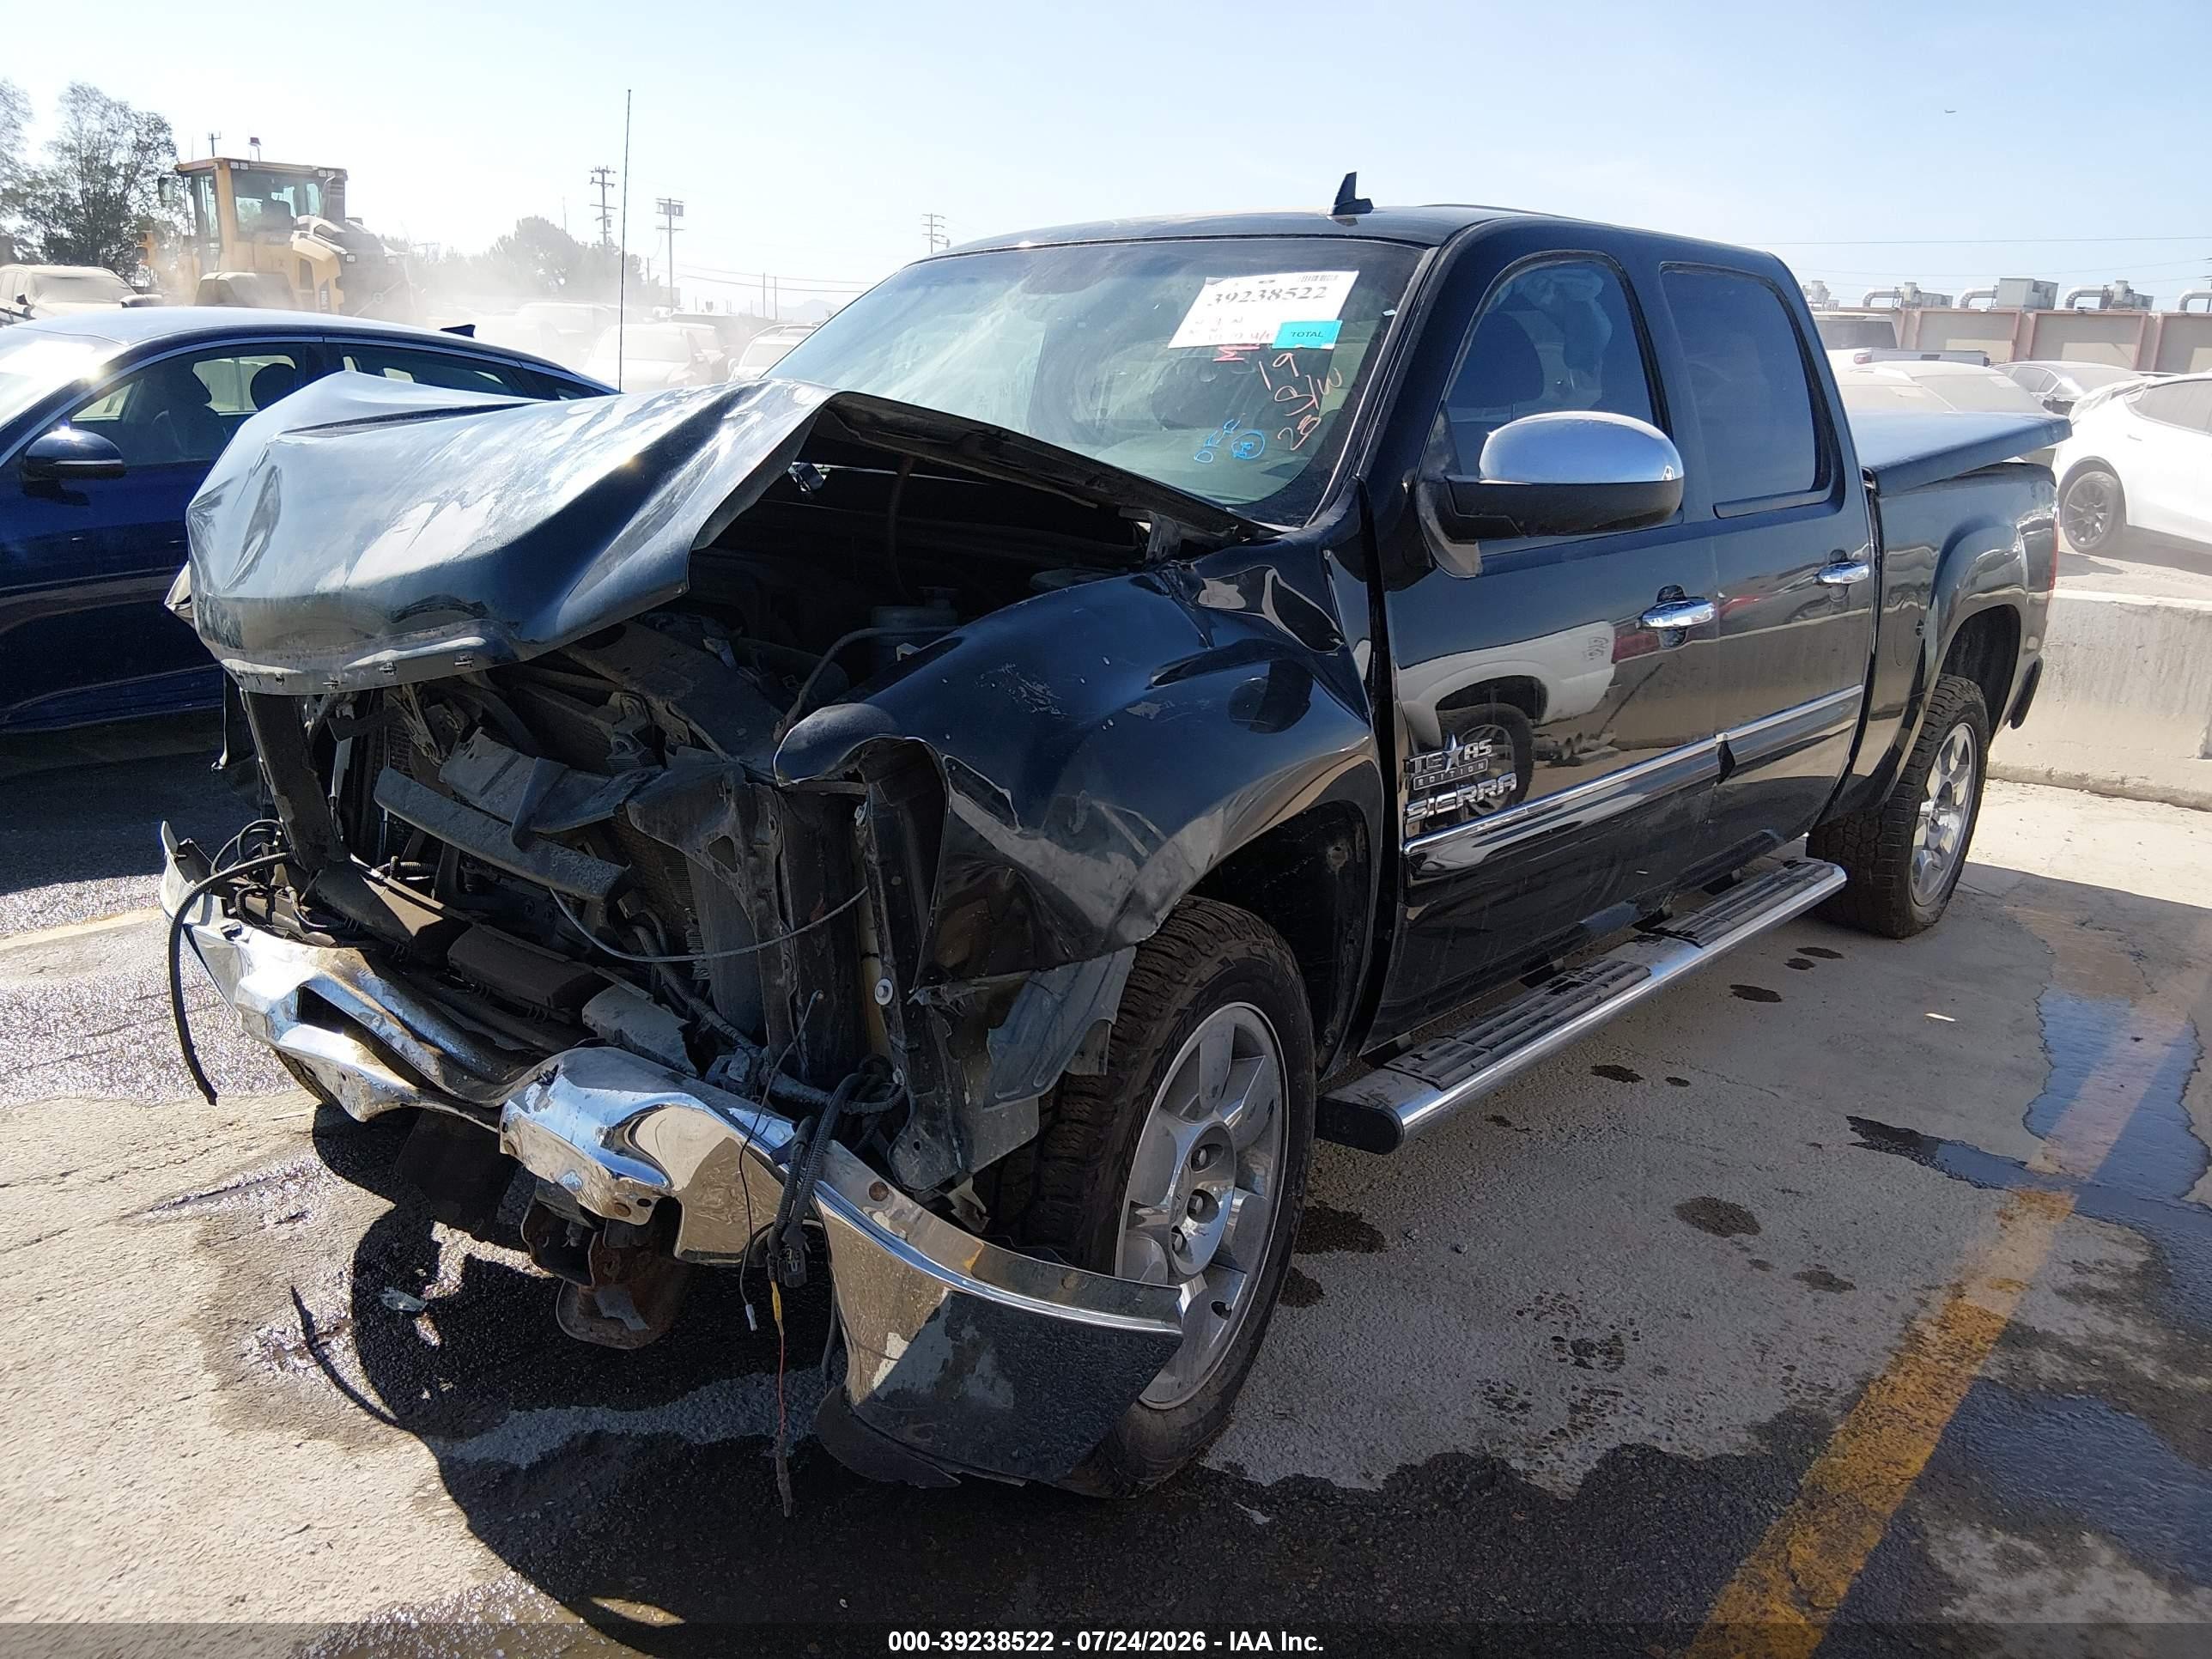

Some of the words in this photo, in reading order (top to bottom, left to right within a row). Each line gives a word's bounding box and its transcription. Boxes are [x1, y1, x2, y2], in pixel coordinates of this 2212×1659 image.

[1207, 286, 1328, 307] 39238522
[1418, 763, 1485, 786] EDITION
[1405, 773, 1517, 825] SIERRA
